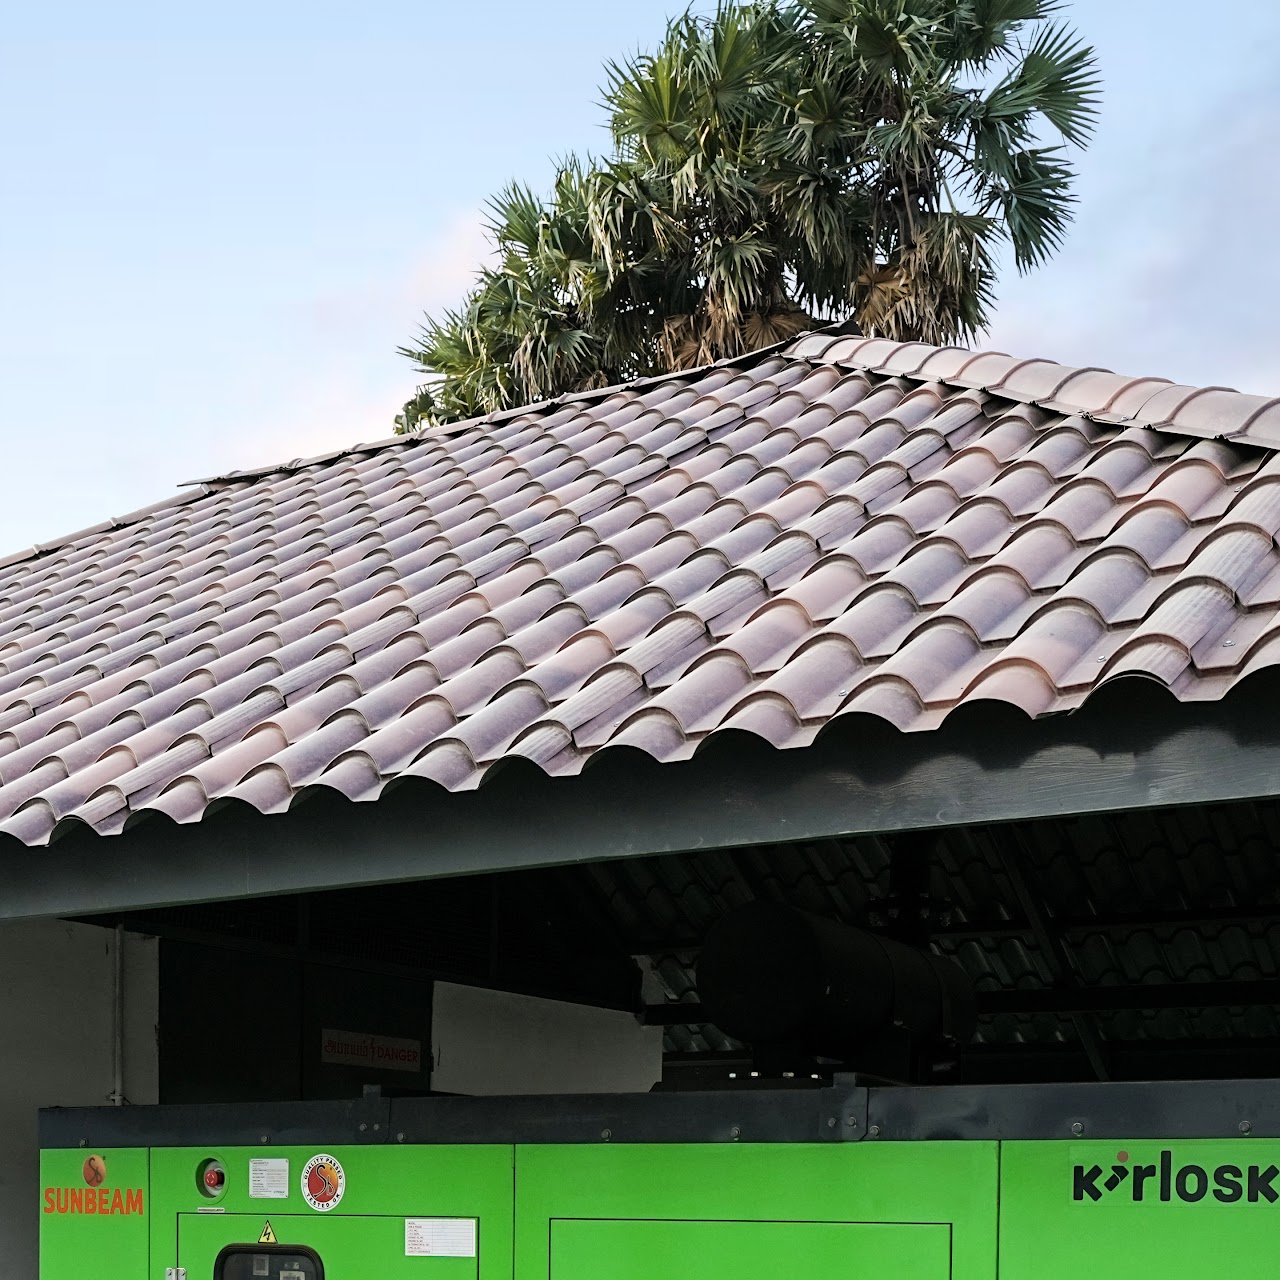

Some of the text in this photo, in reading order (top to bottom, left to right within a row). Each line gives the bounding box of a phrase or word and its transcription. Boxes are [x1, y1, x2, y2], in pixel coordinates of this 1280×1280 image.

[377, 1047, 418, 1063] DANGER
[304, 1157, 324, 1180] QUALITY
[325, 1157, 343, 1180] PASSED
[43, 1187, 144, 1215] SUNBEAM
[306, 1193, 340, 1209] TESTED OK
